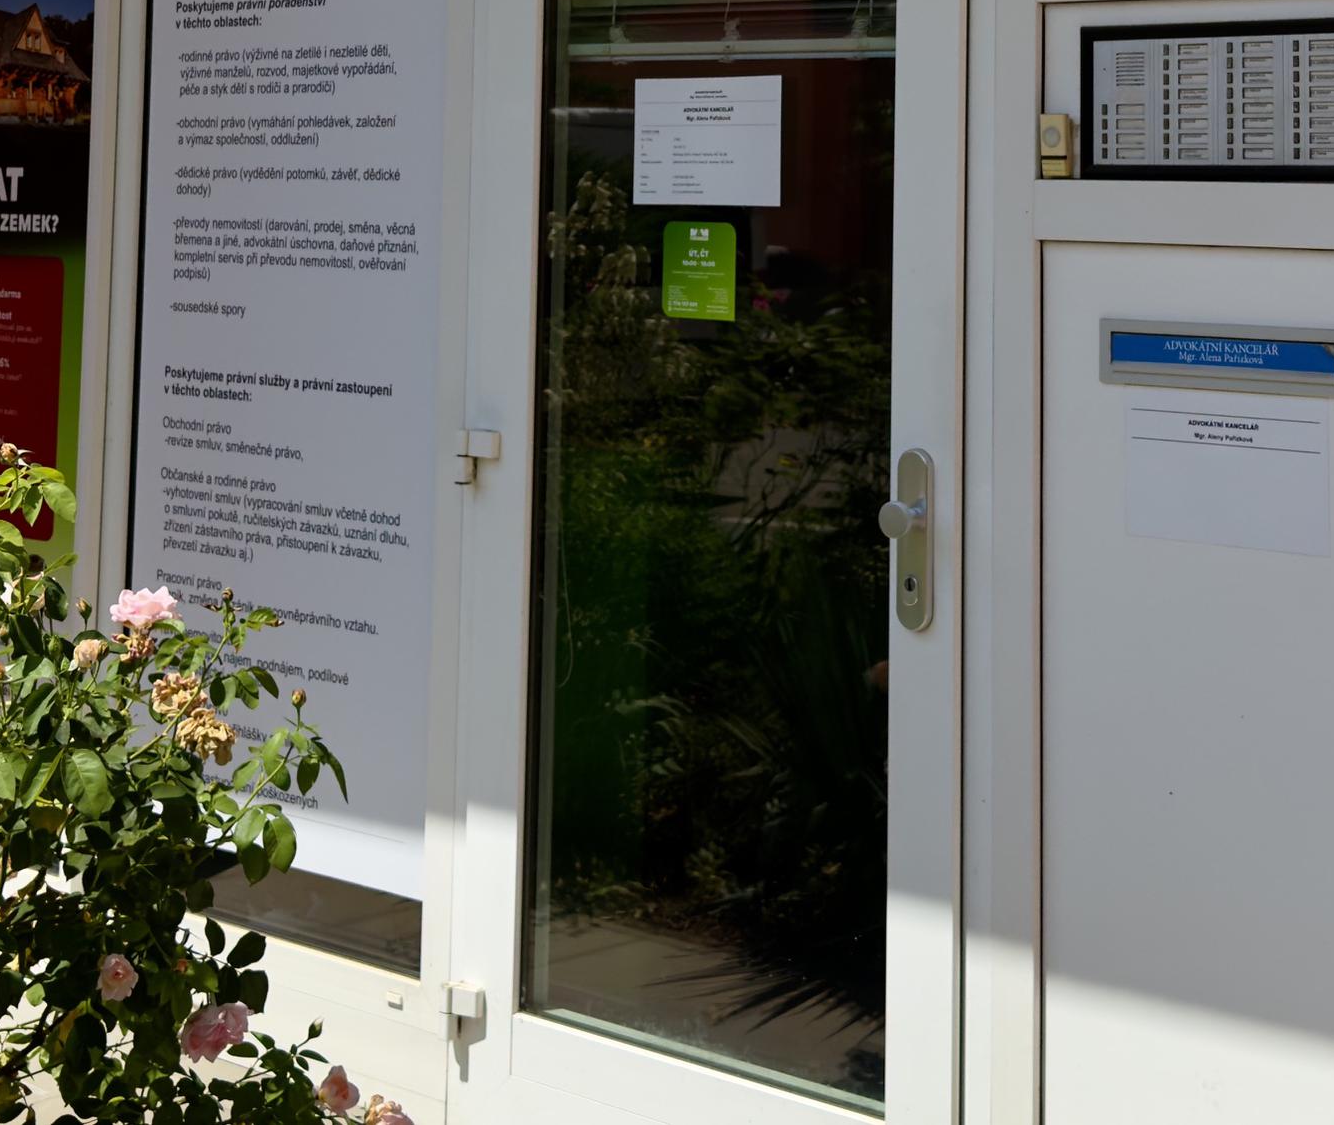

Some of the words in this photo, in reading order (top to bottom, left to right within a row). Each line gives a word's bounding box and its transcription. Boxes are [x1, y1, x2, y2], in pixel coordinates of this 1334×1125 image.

[176, 0, 234, 15] Poskytujeme
[175, 20, 181, 29] v
[183, 17, 212, 29] těchto
[213, 14, 262, 28] oblastech:
[215, 49, 240, 64] právo
[242, 47, 279, 64] (výživné
[281, 49, 293, 60] na
[294, 46, 322, 60] zletilé
[329, 45, 369, 58] nezletilé
[370, 44, 391, 58] děti,
[180, 66, 212, 82] výživné
[214, 65, 254, 78] manželů,
[256, 64, 289, 78] rozvod,
[292, 63, 340, 79] majetkové
[341, 61, 397, 79] vypořádání,
[179, 83, 201, 98] péče
[210, 83, 228, 98] styk
[257, 81, 282, 95] rodiči
[292, 80, 336, 96] prarodiči)
[220, 116, 246, 131] právo
[247, 115, 295, 132] (vymáhání
[297, 115, 353, 131] pohledávek,
[355, 114, 397, 128] založení
[185, 133, 214, 148] výmaz
[270, 132, 320, 148] oddlužení)
[212, 167, 238, 181] právo
[239, 166, 284, 183] (vydědění
[286, 167, 329, 182] potomků,
[363, 167, 401, 181] dědické
[176, 183, 212, 199] dohody)
[212, 218, 263, 231] nemovitostí
[265, 218, 311, 234] (darování,
[313, 220, 346, 236] prodej,
[348, 221, 383, 236] směna,
[386, 221, 416, 236] věcná
[174, 232, 213, 246] břemena
[222, 234, 241, 250] jiné,
[243, 235, 288, 248] advokátní
[290, 236, 337, 251] úschovna,
[339, 238, 375, 252] daňové
[377, 239, 419, 255] přiznání,
[174, 250, 216, 265] kompletní
[218, 252, 244, 265] servis
[246, 252, 258, 267] při
[259, 252, 297, 268] převodu
[299, 256, 356, 270] nemovitostí,
[358, 257, 407, 271] ověřování
[173, 266, 211, 282] podpisů)
[221, 304, 246, 319] spory
[1164, 340, 1222, 353] ADVOKÁTNÍ
[1224, 343, 1279, 356] KANCELÁŘ
[1179, 351, 1198, 362] Mgr.
[1201, 352, 1222, 362] Alena
[1224, 353, 1263, 364] Pařízková
[164, 365, 224, 384] Poskytujeme
[226, 371, 257, 386] právní
[258, 373, 291, 391] služby
[293, 379, 300, 389] a
[302, 377, 334, 392] právní
[335, 381, 393, 398] zastoupení
[171, 383, 201, 397] těchto
[202, 386, 252, 402] oblastech:
[162, 415, 204, 432] Obchodní
[206, 421, 232, 436] právo
[1188, 419, 1224, 428] ADVOKÁTNÍ
[1224, 422, 1259, 431] KANCELÁŘ
[195, 437, 223, 452] smluv,
[225, 440, 273, 457] směnečné
[274, 446, 304, 461] právo,
[160, 466, 205, 484] Občanské
[214, 474, 248, 489] rodinné
[250, 479, 277, 493] právo
[215, 492, 242, 506] smluv
[243, 494, 303, 513] (vypracování
[305, 503, 333, 518] smluv
[335, 506, 368, 522] včetně
[369, 510, 401, 527] dohod
[172, 504, 206, 518] smluvní
[208, 508, 241, 524] pokutě,
[243, 513, 297, 533] ručitelských
[299, 522, 341, 537] závazků,
[344, 528, 377, 541] uznání
[379, 530, 409, 548] dluhu,
[163, 518, 193, 534] zřízení
[194, 524, 244, 541] zástavního
[245, 531, 274, 547] práva,
[276, 534, 329, 554] přistoupení
[339, 544, 382, 563] závazku,
[163, 535, 198, 552] převzetí
[199, 542, 237, 558] závazku
[238, 548, 254, 563] aj.)
[156, 568, 195, 586] Pracovní
[196, 577, 223, 591] právo
[344, 618, 380, 636] vztahu.
[307, 667, 349, 686] podílové
